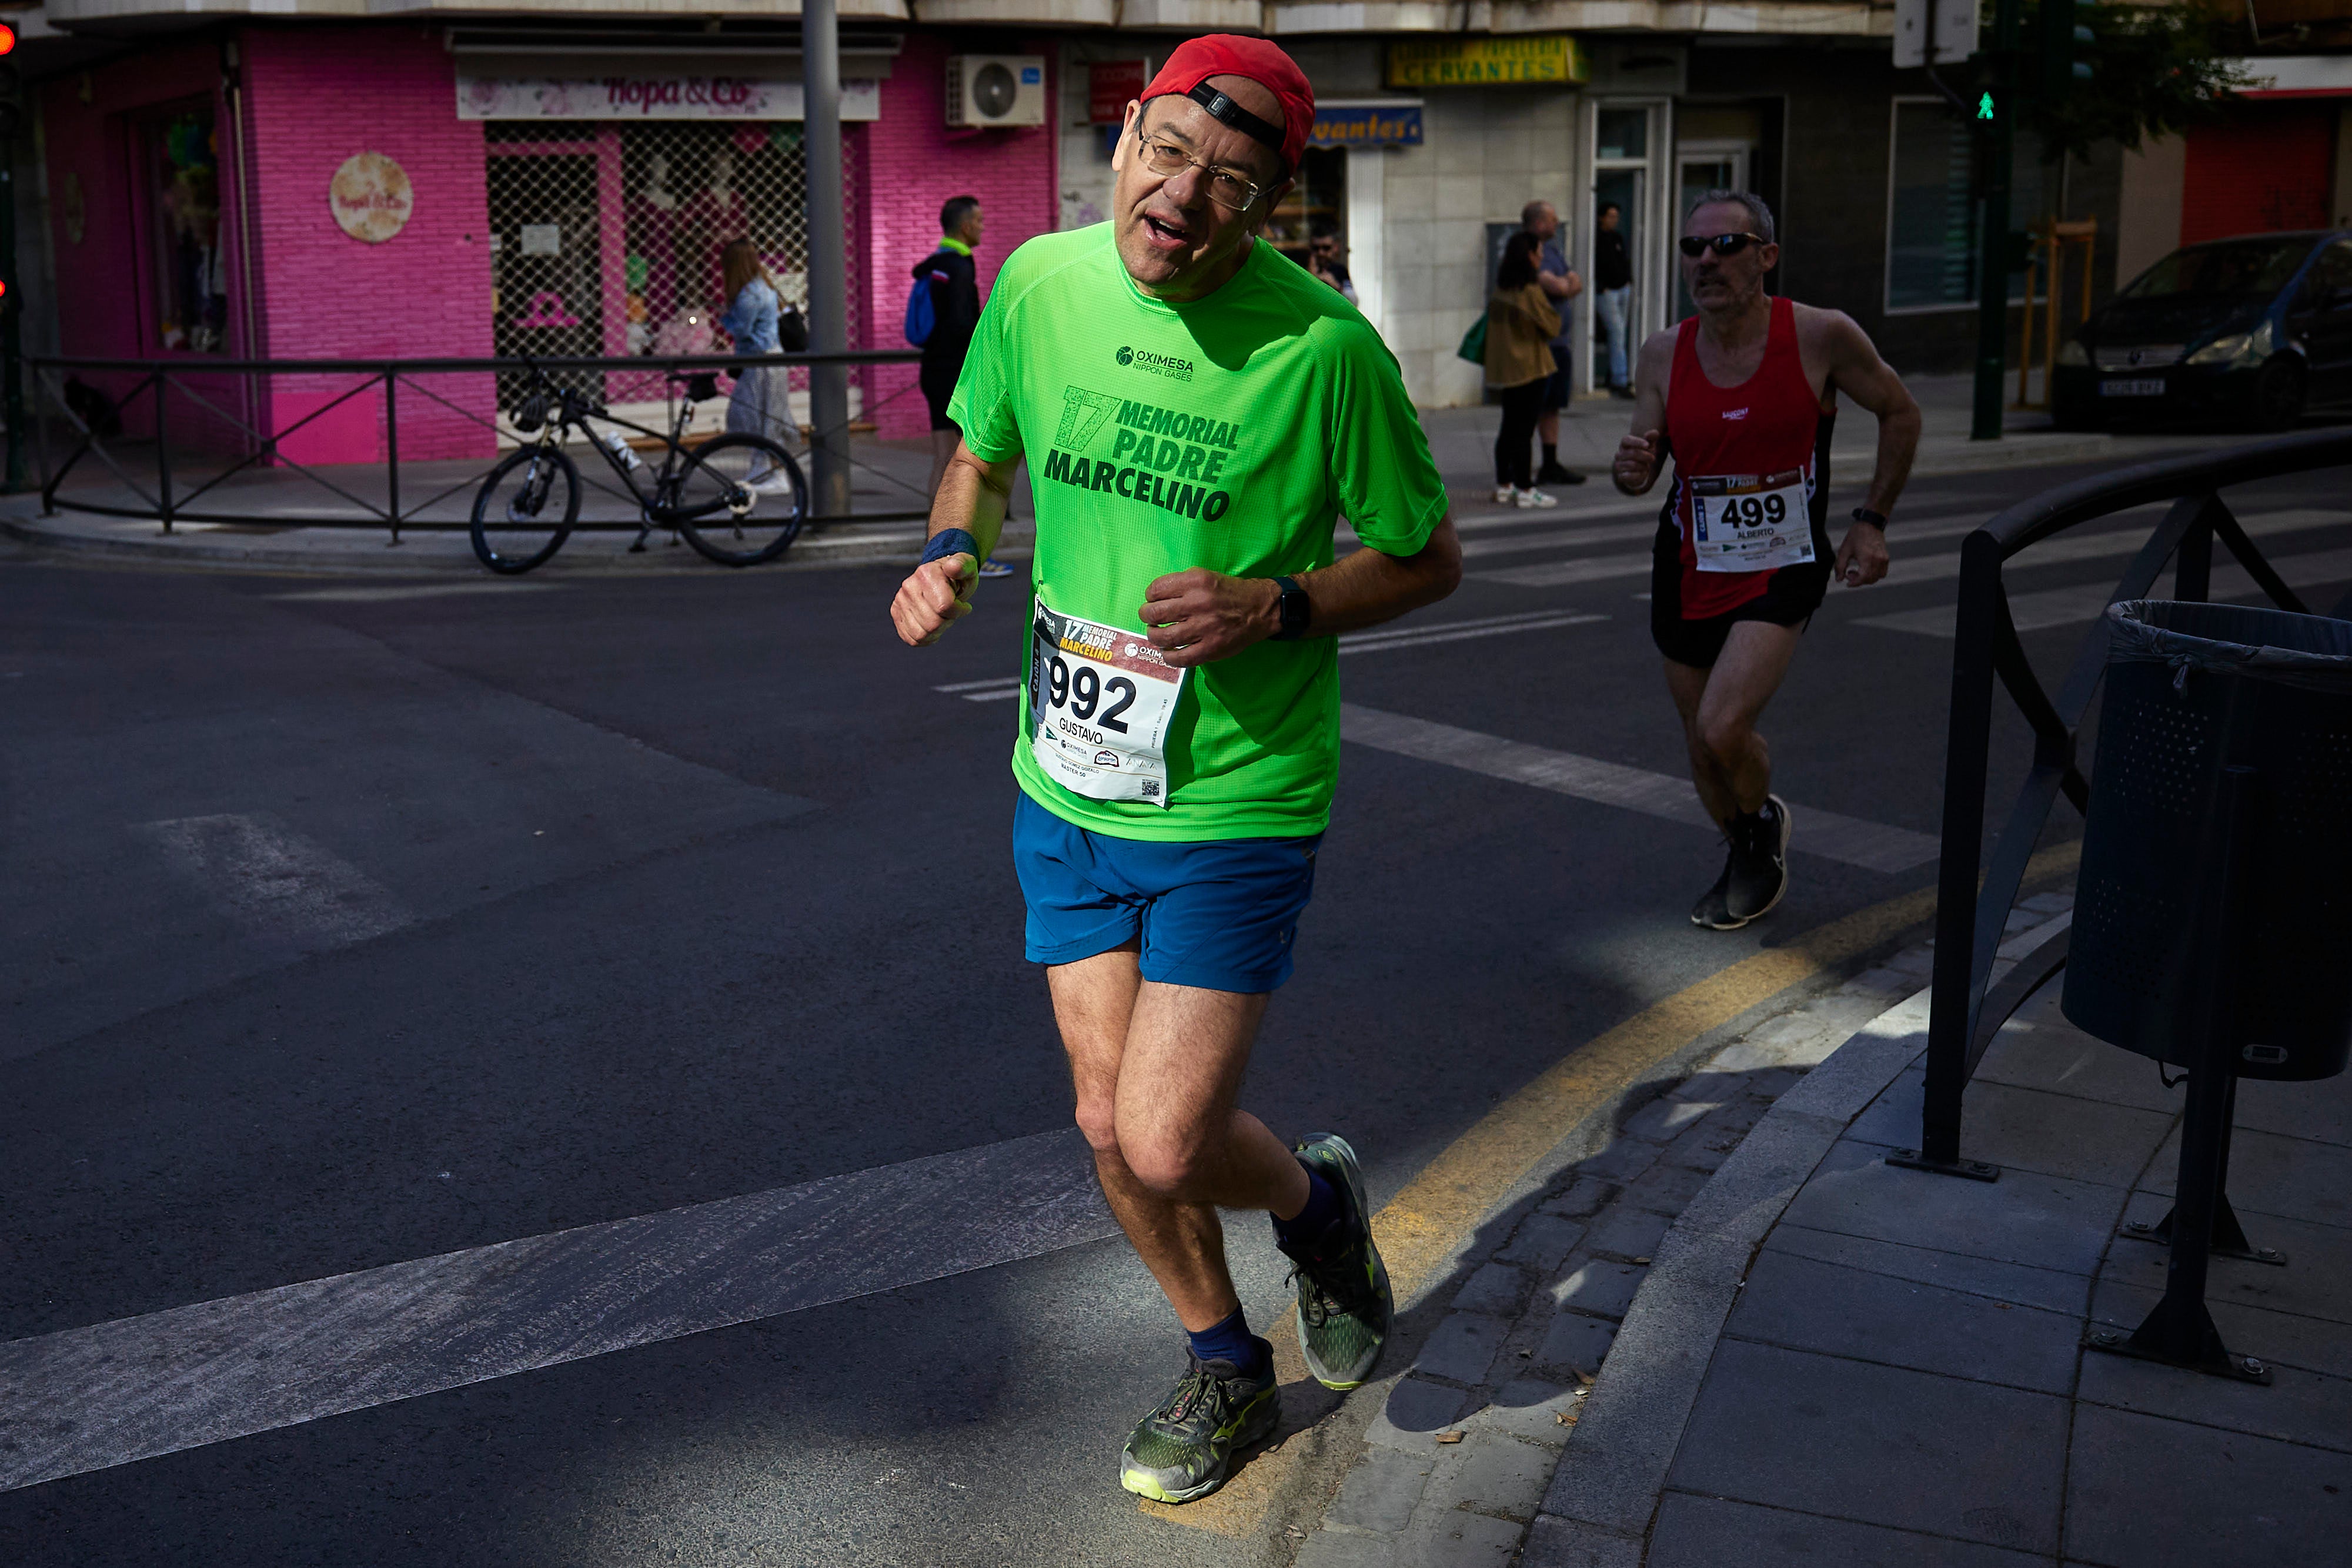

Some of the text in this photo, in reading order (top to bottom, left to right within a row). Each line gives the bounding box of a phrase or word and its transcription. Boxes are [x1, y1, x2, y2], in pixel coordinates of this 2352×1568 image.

[1404, 59, 1555, 84] CERVANTES
[1312, 113, 1405, 140] vantes
[1133, 362, 1192, 382] NIPPON GASES
[1137, 350, 1193, 372] OXIMESA
[1054, 385, 1240, 452] 17 MEMORIAL
[1112, 428, 1228, 484] PADRE
[1044, 448, 1230, 522] MARCELINO
[1721, 494, 1785, 529] 499
[1738, 528, 1774, 539] ALBERTO
[1064, 619, 1084, 640] 17
[1082, 624, 1117, 640] MEMORIAL
[1079, 631, 1113, 650] PADRE
[1060, 637, 1113, 661] MARCELINO
[1137, 654, 1158, 664] NIPPON
[1140, 646, 1164, 659] OXIM
[1050, 656, 1136, 734] 992
[1060, 717, 1103, 744] GUSTAVO
[1067, 742, 1087, 755] OXIMESA
[1061, 763, 1078, 775] MASTER
[1126, 758, 1157, 770] ANAYA
